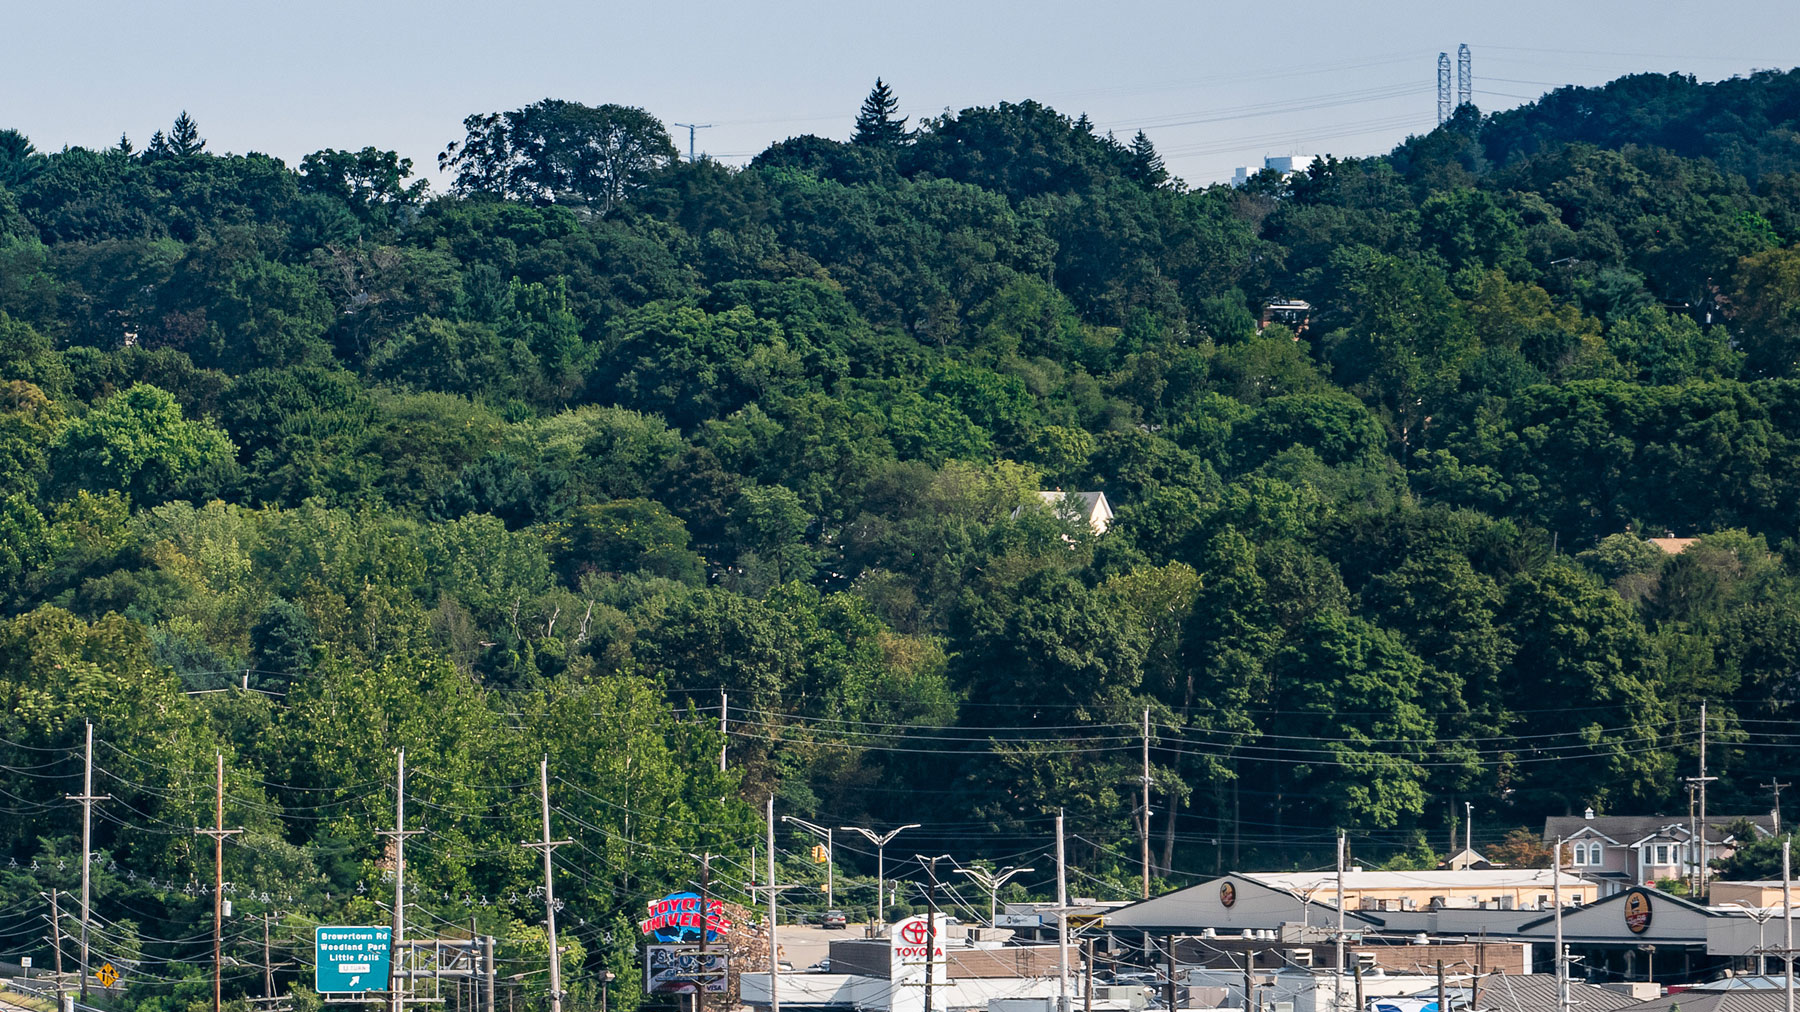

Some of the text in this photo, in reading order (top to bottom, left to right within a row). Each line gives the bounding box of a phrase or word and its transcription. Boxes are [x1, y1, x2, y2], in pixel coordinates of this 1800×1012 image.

[641, 911, 733, 936] UNIVERSE
[321, 932, 388, 940] Browertown Rd
[320, 943, 387, 951] Woodland Park
[895, 947, 943, 957] TOYOA
[329, 953, 379, 961] Little Falls
